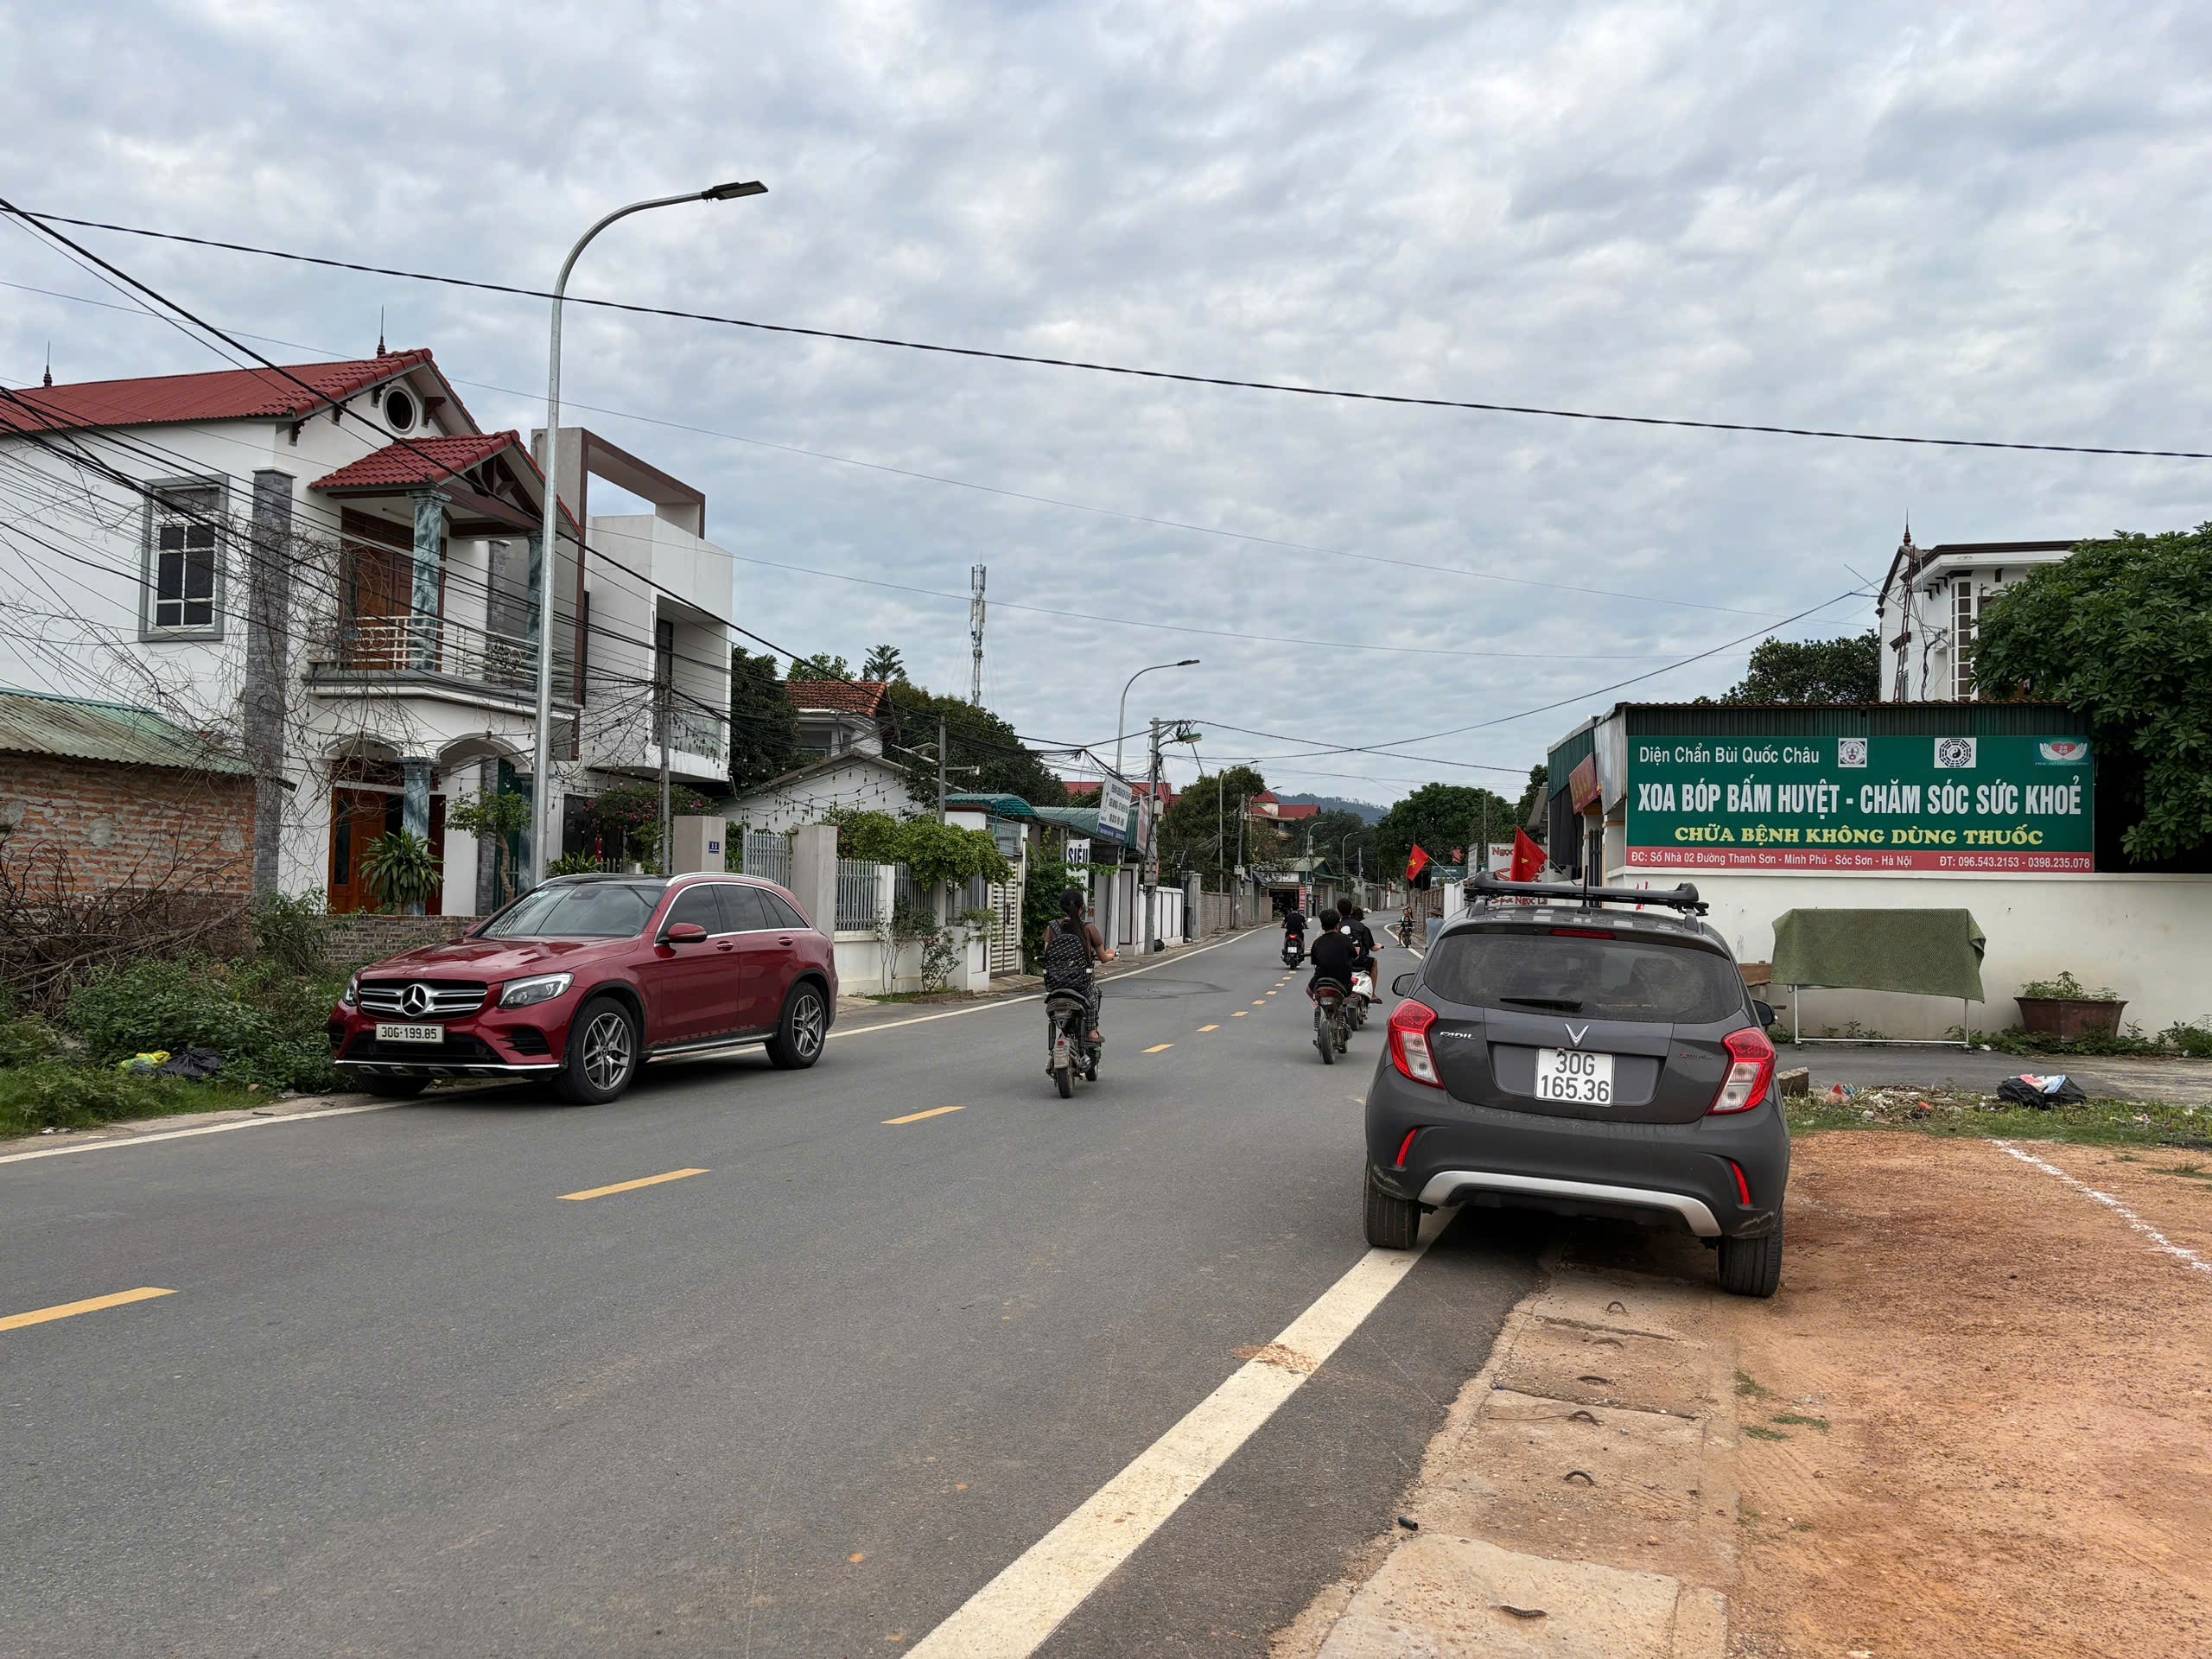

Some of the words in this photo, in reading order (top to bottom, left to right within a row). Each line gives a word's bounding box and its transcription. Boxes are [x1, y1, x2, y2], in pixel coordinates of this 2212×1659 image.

[1639, 747, 1670, 766] Diện
[1675, 743, 1711, 763] Chẩn
[1715, 746, 1738, 763] Bùi
[1742, 744, 1778, 765] Quốc
[1783, 747, 1820, 764] Châu
[1637, 783, 1676, 811] XOA
[1681, 778, 1721, 813] BÓP
[1727, 774, 1771, 813] BẤM
[1777, 779, 1840, 820] HUYỆT
[1860, 779, 1921, 814] CHĂM
[1927, 779, 1969, 815] SÓC
[1975, 779, 2018, 815] SỨC
[2025, 775, 2082, 815] KHOẺ
[1675, 823, 1736, 842] CHỮA
[1741, 824, 1800, 846] BỆNH
[1805, 824, 1885, 844] KHÔNG
[1891, 825, 1957, 845] DÙNG
[1962, 823, 2044, 845] THUỐC
[1631, 852, 1648, 862] ĐC:
[1650, 850, 1662, 862] Số
[1664, 852, 1681, 862] Nhà
[1684, 853, 1694, 863] 02
[1697, 852, 1726, 865] Đường
[1728, 853, 1757, 864] Thanh
[1758, 854, 1776, 864] Sơn
[1784, 854, 1807, 864] Minh
[1809, 854, 1827, 864] Phú
[1835, 855, 1853, 865] Sóc
[1855, 855, 1873, 865] Sơn
[1881, 855, 1894, 866] Hà
[1897, 855, 1912, 868] Nội
[1940, 856, 1955, 867] ĐT:
[1958, 856, 2019, 868] 096.543.2153
[2028, 856, 2090, 868] 0398.235.078
[1555, 1052, 1595, 1076] 30G
[1541, 1074, 1610, 1102] 165.36
